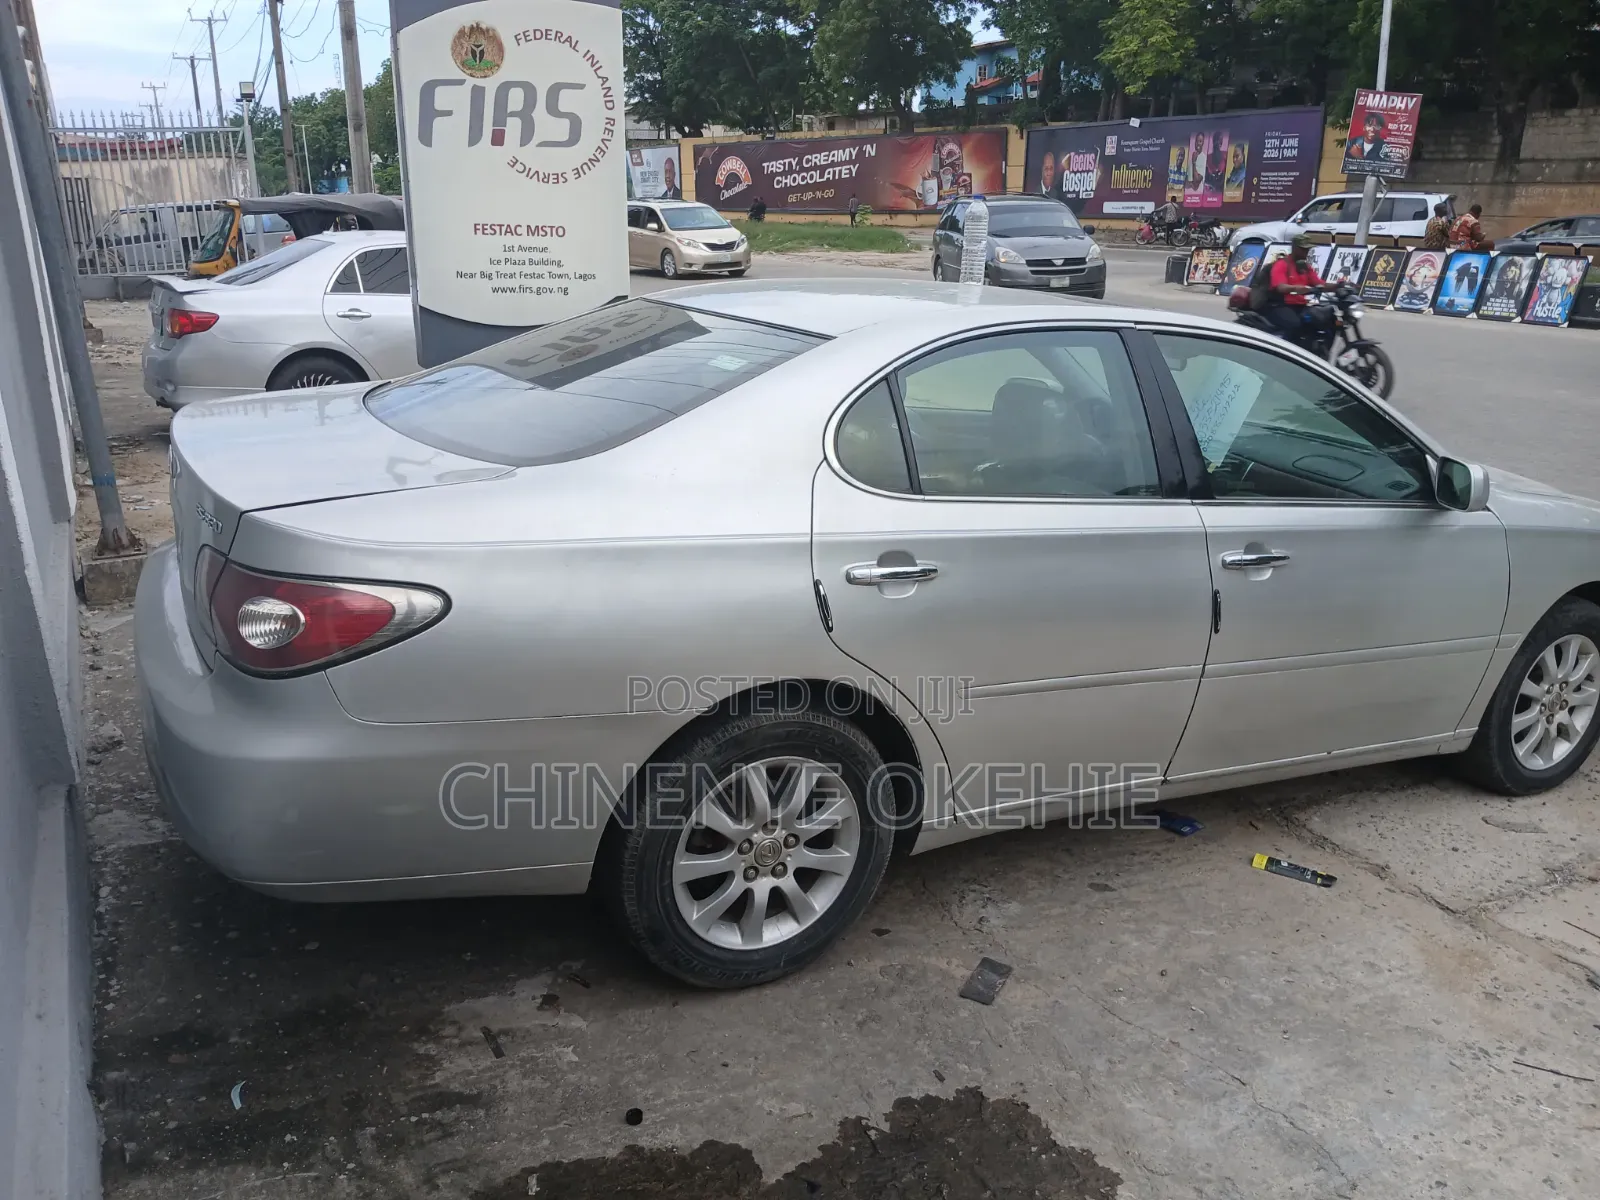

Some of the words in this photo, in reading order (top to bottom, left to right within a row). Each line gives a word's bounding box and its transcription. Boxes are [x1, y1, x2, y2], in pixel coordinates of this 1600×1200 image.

[514, 28, 580, 53] FEDERAL
[582, 49, 616, 111] INLAND
[417, 78, 587, 148] FIRS
[572, 116, 616, 180] REVENUE
[1264, 138, 1280, 148] 12TH
[1280, 137, 1299, 148] JUNE
[1282, 148, 1298, 158] 9AM
[506, 155, 569, 185] SERVICE
[717, 158, 748, 181] COWBELL
[761, 160, 801, 177] TASTY,
[802, 147, 858, 168] CREAMY
[1069, 151, 1096, 172] Teens
[773, 163, 860, 189] CHOCOLATEY
[1062, 168, 1097, 199] Gospel
[1111, 163, 1153, 189] Influence
[473, 223, 523, 237] FESTAC
[526, 224, 567, 238] MSTO
[502, 243, 516, 253] 1st
[489, 257, 502, 266] Ice
[504, 258, 526, 267] Plaza
[528, 258, 565, 269] Building,
[456, 270, 477, 280] Near
[479, 270, 494, 283] Big
[495, 271, 515, 281] Treat
[518, 271, 545, 281] Festac
[547, 271, 572, 283] Town,
[573, 272, 597, 283] Lagos
[1533, 301, 1563, 319] Hustle
